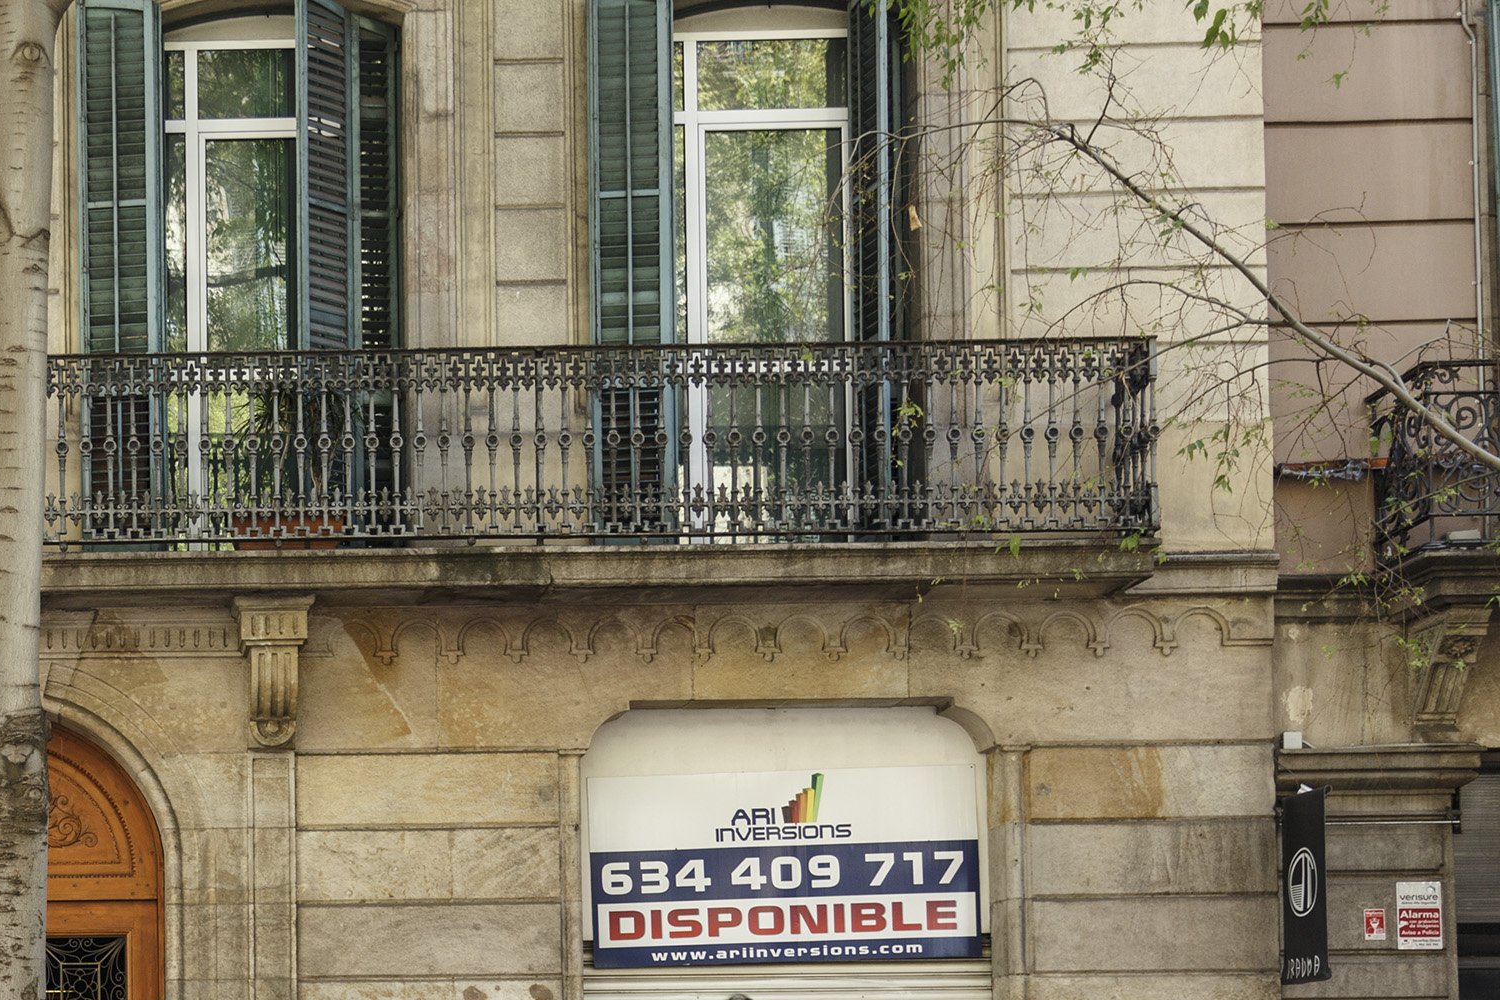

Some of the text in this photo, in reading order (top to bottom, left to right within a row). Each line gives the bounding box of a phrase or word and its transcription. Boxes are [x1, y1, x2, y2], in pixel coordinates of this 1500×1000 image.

[730, 807, 776, 825] ARI
[601, 850, 965, 896] 634 409 717
[608, 900, 959, 942] DISPONIBLE
[1399, 910, 1439, 919] Alarma
[651, 942, 924, 961] www.ariinversions.com
